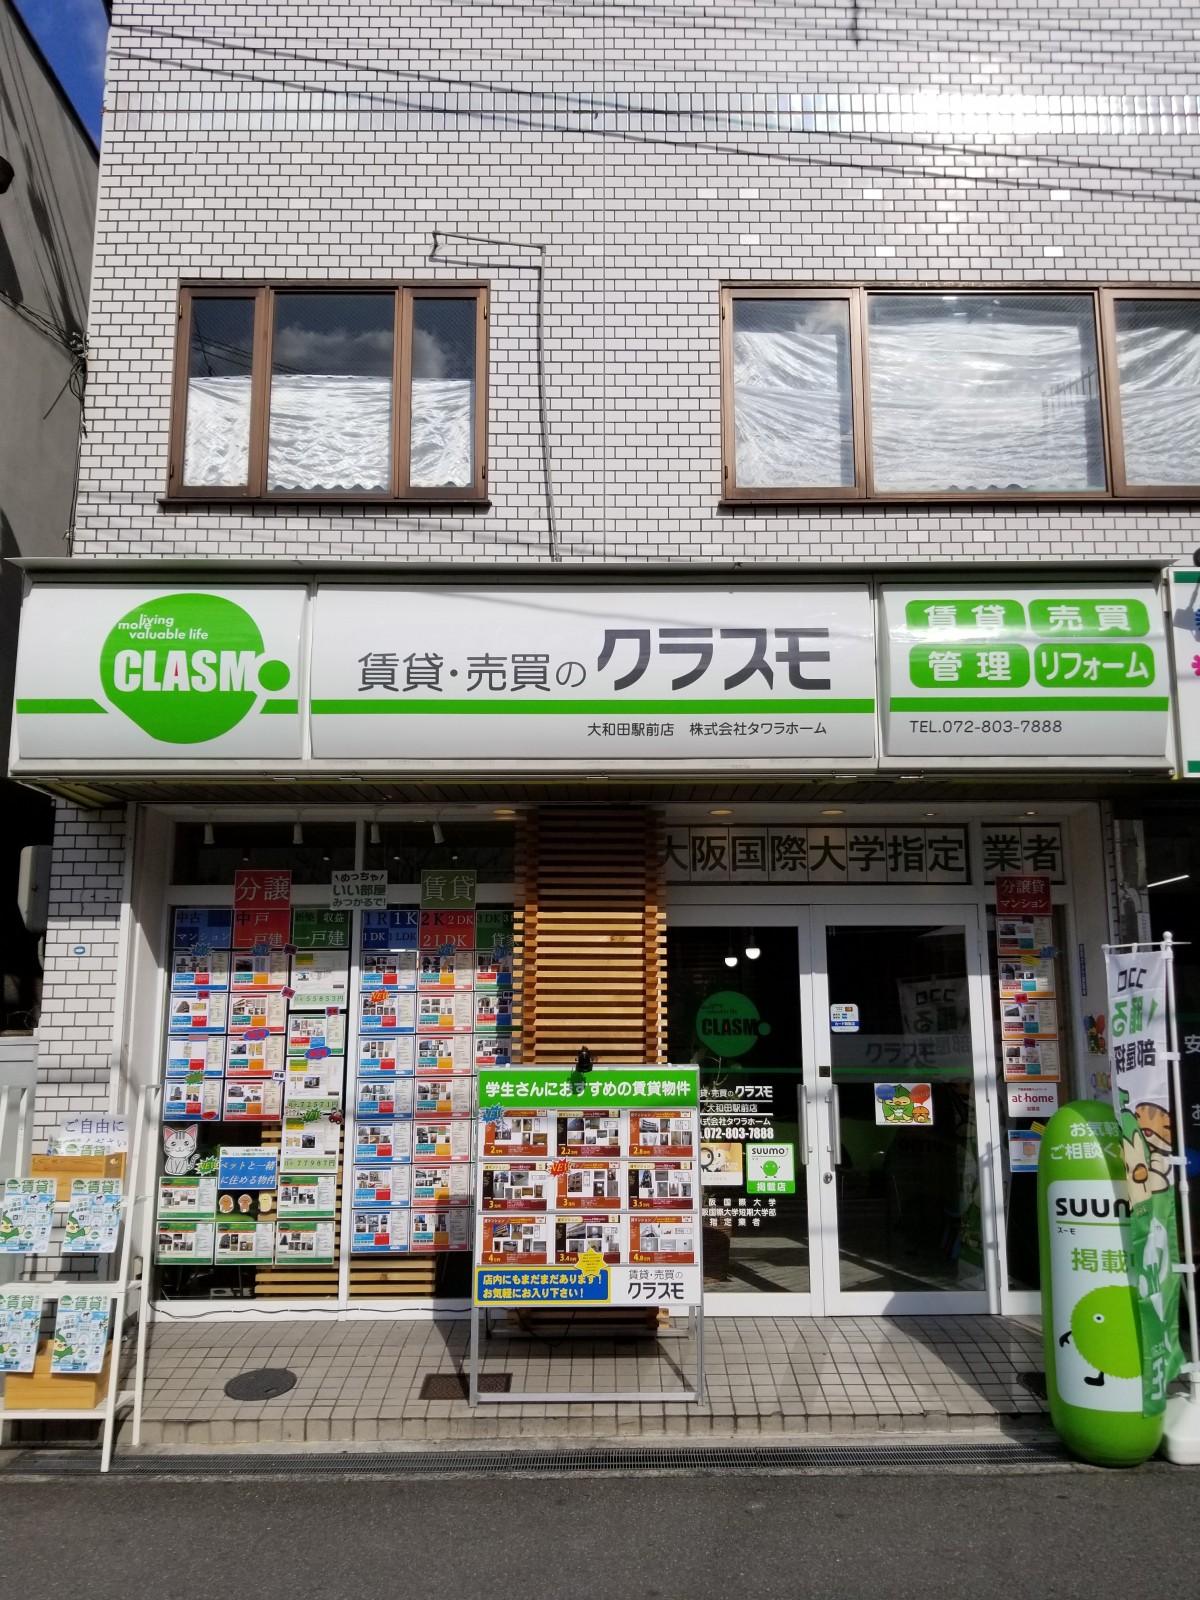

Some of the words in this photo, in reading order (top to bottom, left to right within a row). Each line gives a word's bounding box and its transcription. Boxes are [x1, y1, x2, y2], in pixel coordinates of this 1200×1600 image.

[139, 613, 175, 628] living
[924, 604, 1007, 632] 賃貸
[1048, 604, 1132, 632] 売買
[129, 628, 185, 640] valuable
[189, 628, 209, 640] life
[928, 650, 1012, 683] 管理
[1041, 648, 1151, 682] リフォーム
[587, 722, 675, 737] 大和田駅前店
[689, 722, 827, 737] 株式会社タワラホーム
[910, 719, 1062, 735] TEL.072-803-7888
[659, 834, 965, 873] 大阪国際大学指定
[983, 834, 1061, 873] 業者
[236, 877, 290, 901] 分譲
[332, 885, 387, 896] いい部屋
[423, 876, 475, 901] 賃貸
[295, 930, 345, 947] 一戸建
[485, 1080, 691, 1098] 学生さんにおすすめの賃貸物件
[706, 1103, 758, 1113] 大和田駅前店
[66, 1118, 125, 1134] ご自由に
[1057, 1226, 1076, 1235] スーモ
[628, 1269, 684, 1280] 賃貸・売買の
[482, 1287, 584, 1299] お気軽にお入り下さい！
[628, 1282, 684, 1300] クラスモ
